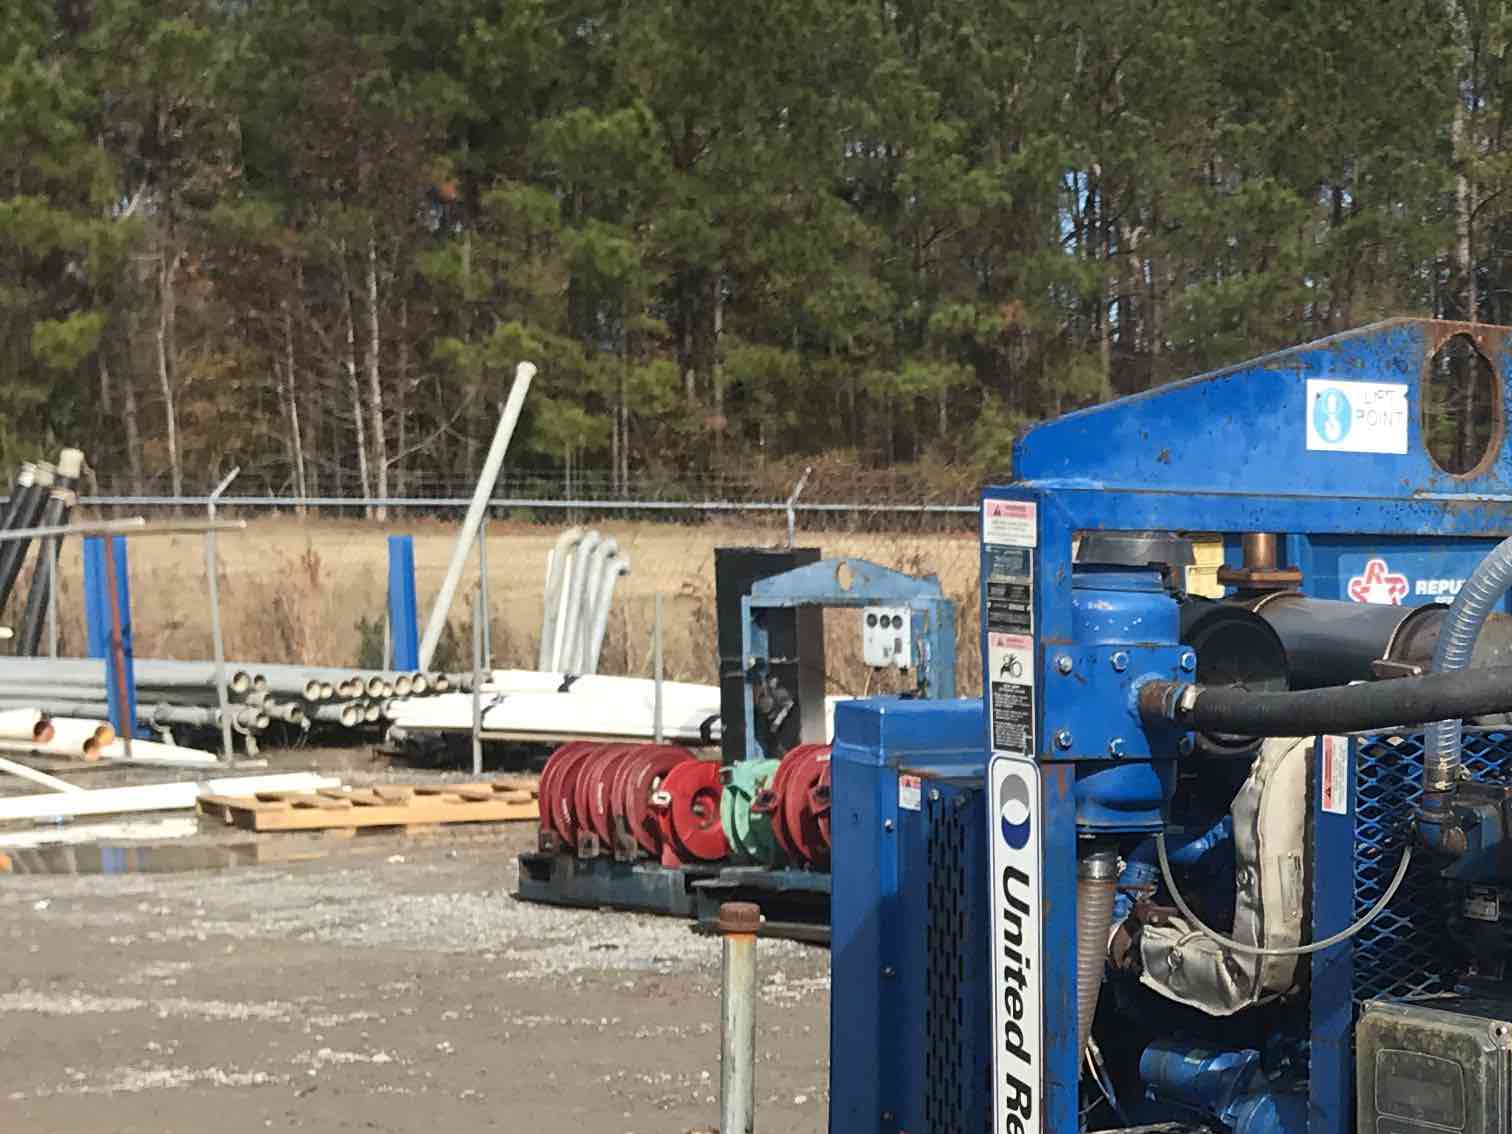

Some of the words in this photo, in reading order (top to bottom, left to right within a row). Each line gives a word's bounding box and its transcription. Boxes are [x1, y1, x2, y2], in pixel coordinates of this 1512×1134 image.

[1363, 388, 1397, 406] LIFT
[1356, 407, 1404, 428] POINT
[1003, 865, 1032, 1065] United
